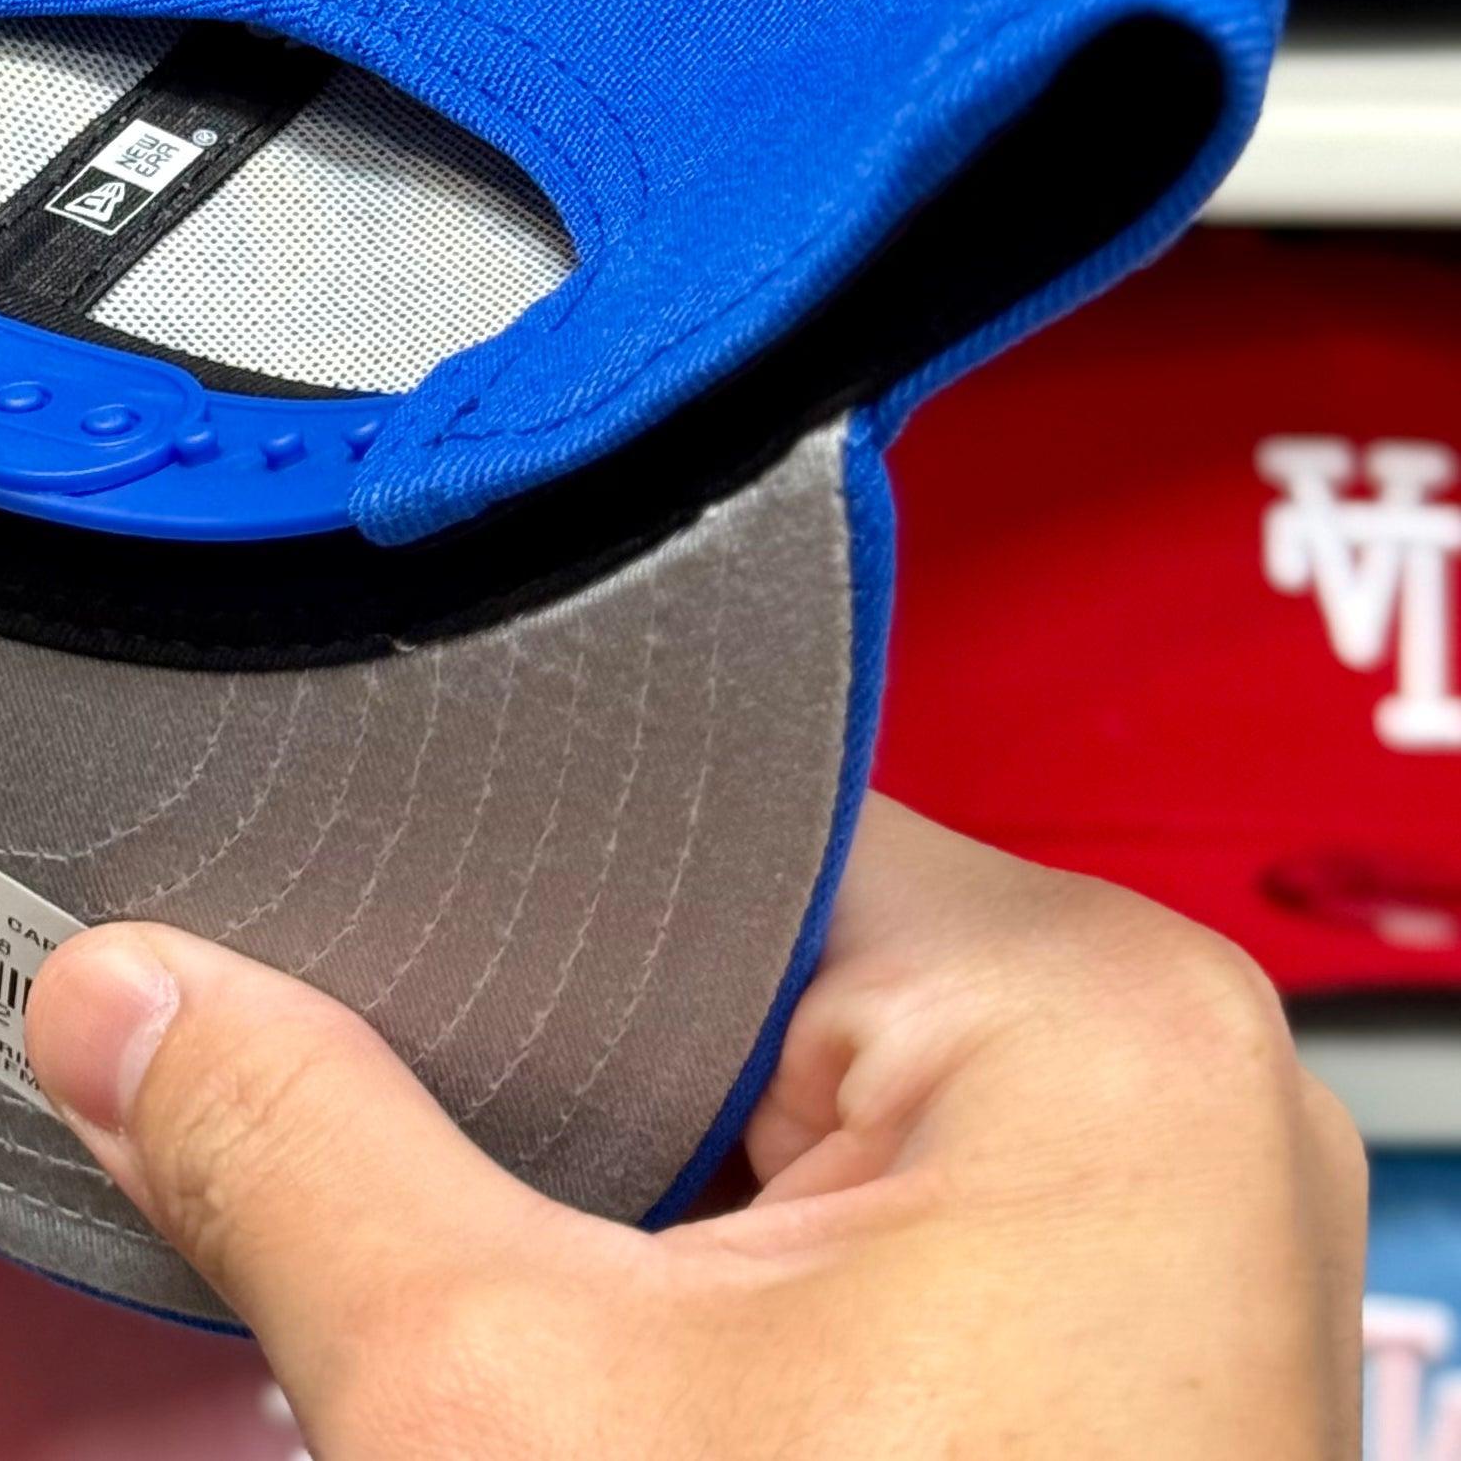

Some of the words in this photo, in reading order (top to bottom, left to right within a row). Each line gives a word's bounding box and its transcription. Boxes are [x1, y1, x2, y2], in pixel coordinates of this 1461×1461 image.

[115, 133, 161, 170] NEW
[135, 142, 180, 178] ERA
[8, 915, 58, 951] CAP
